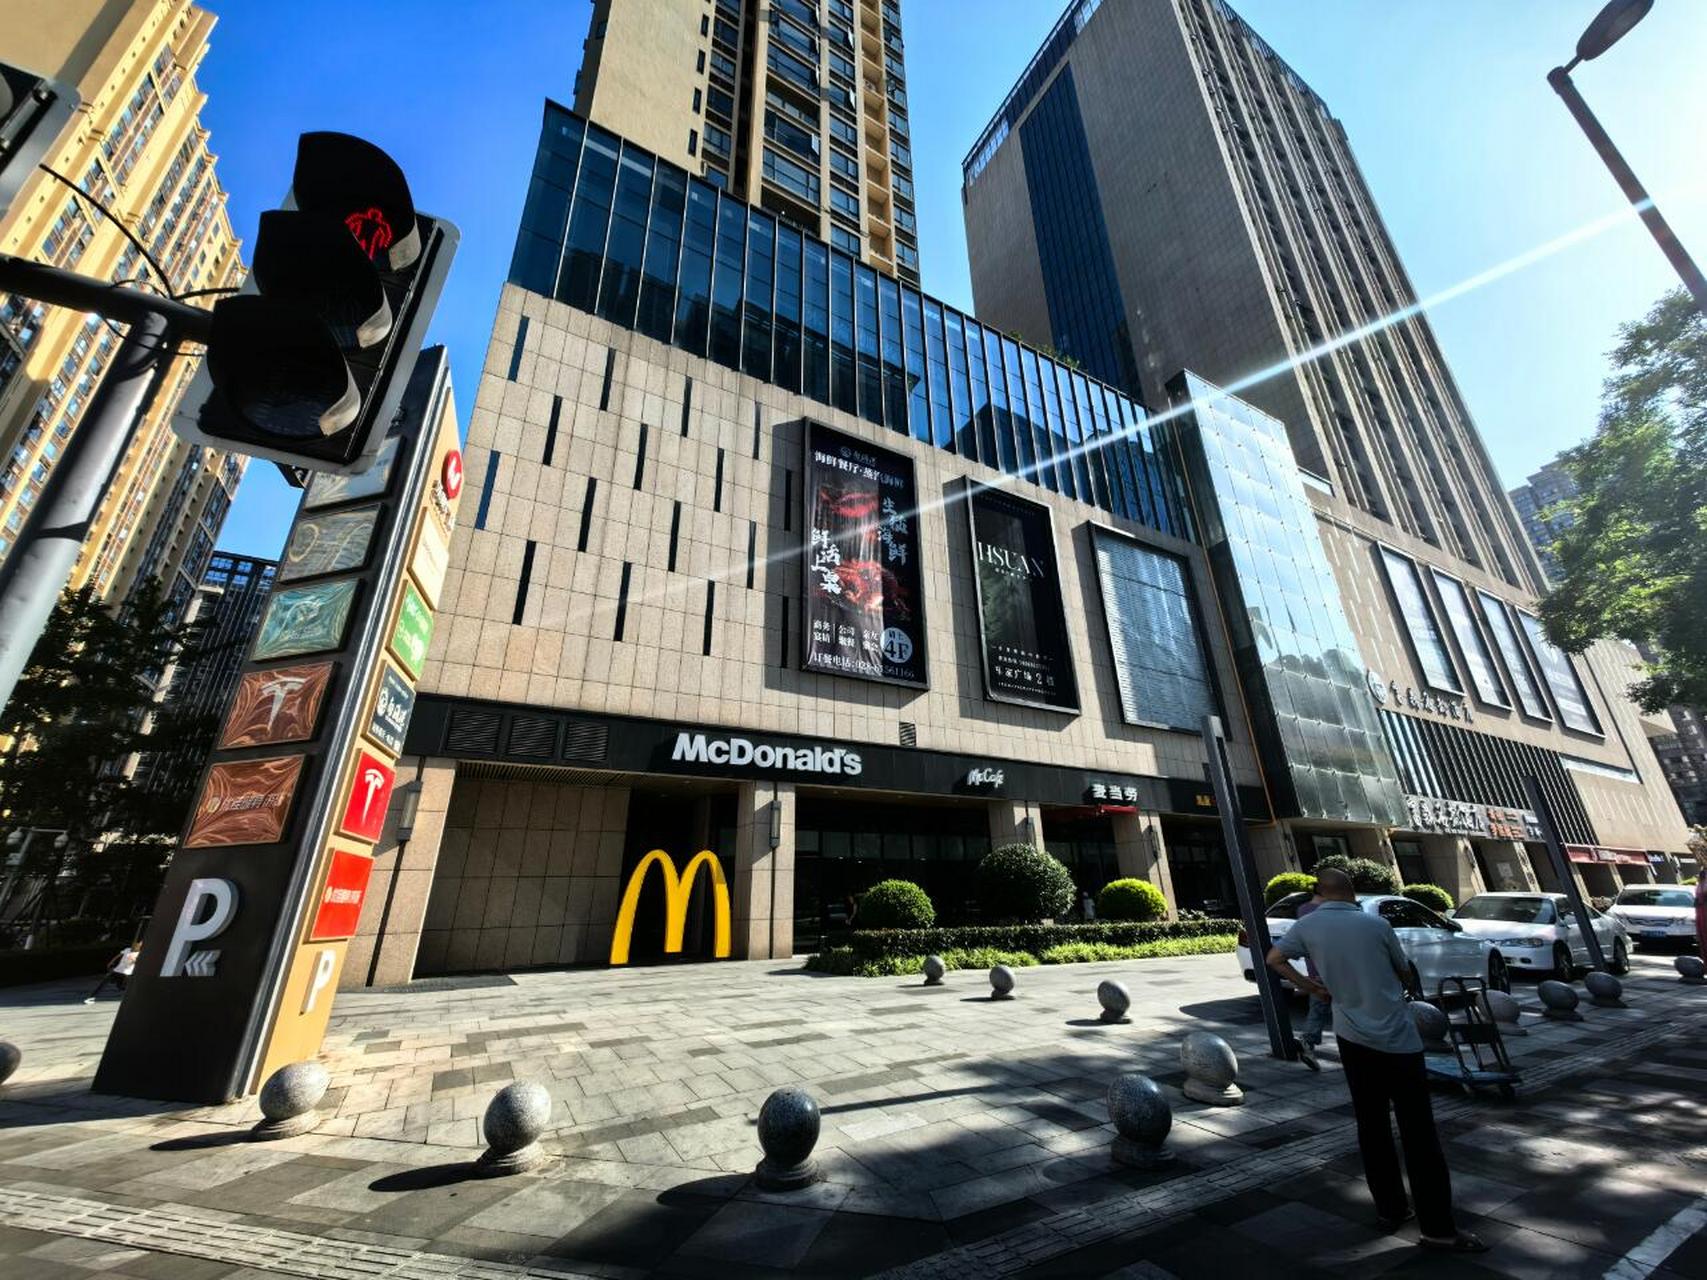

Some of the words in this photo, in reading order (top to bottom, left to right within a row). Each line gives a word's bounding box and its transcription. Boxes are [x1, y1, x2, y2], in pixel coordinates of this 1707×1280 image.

[883, 639, 909, 661] 4F
[671, 732, 862, 776] McDonald's
[1092, 783, 1138, 802] 麦当劳
[160, 878, 237, 977] P
[304, 949, 337, 1013] P
